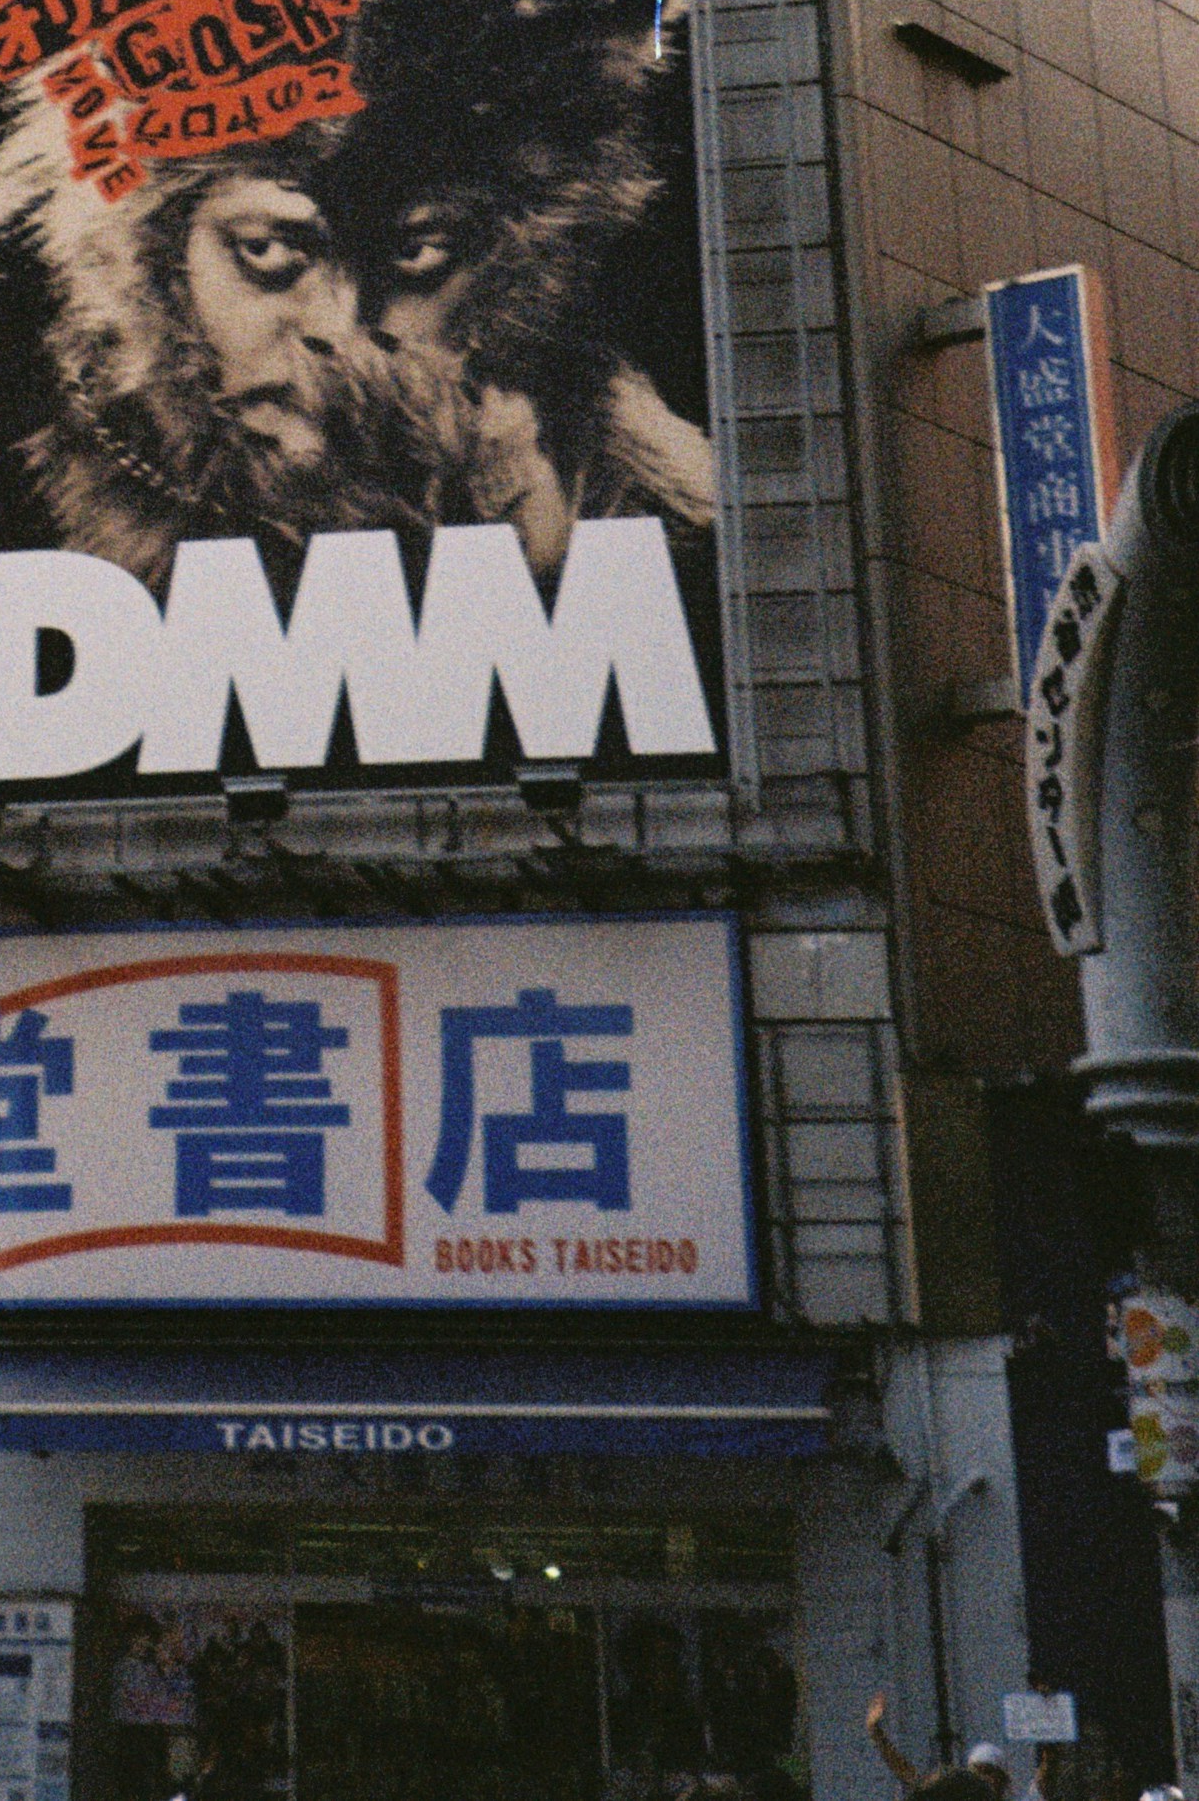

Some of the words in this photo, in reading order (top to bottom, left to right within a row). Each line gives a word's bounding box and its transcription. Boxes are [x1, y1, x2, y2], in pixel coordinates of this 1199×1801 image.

[434, 1238, 537, 1275] BOOKS
[552, 1237, 699, 1275] TAISEIDO
[216, 1422, 456, 1452] TAISEIDO
